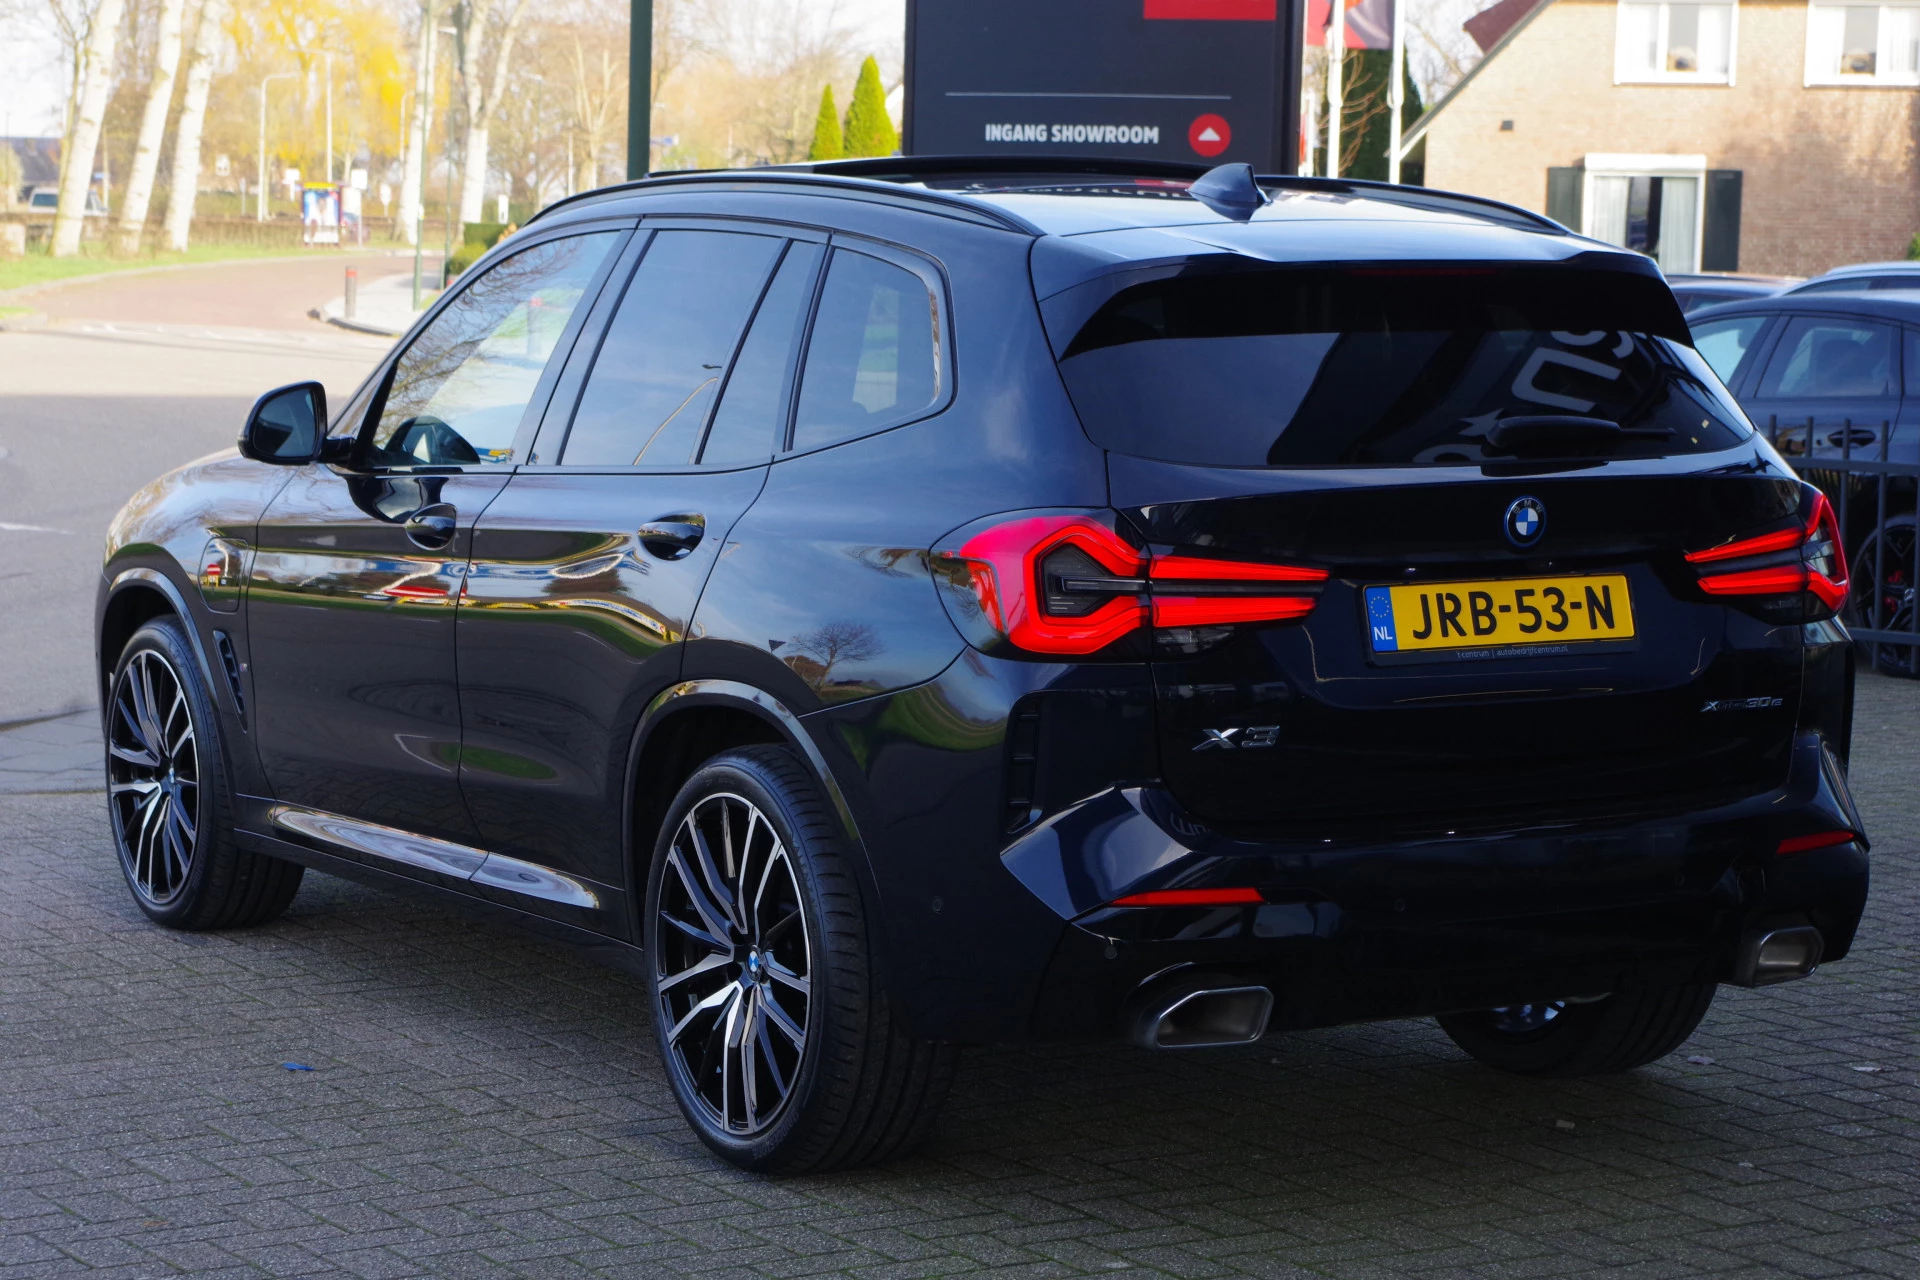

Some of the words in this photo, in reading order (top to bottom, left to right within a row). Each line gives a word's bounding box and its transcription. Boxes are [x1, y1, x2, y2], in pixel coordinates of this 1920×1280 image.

[985, 123, 1048, 143] INGANG
[1051, 124, 1160, 144] SHOWROOM
[1412, 585, 1616, 641] JRB-53-N
[1373, 626, 1393, 641] NL
[1191, 725, 1281, 752] X3
